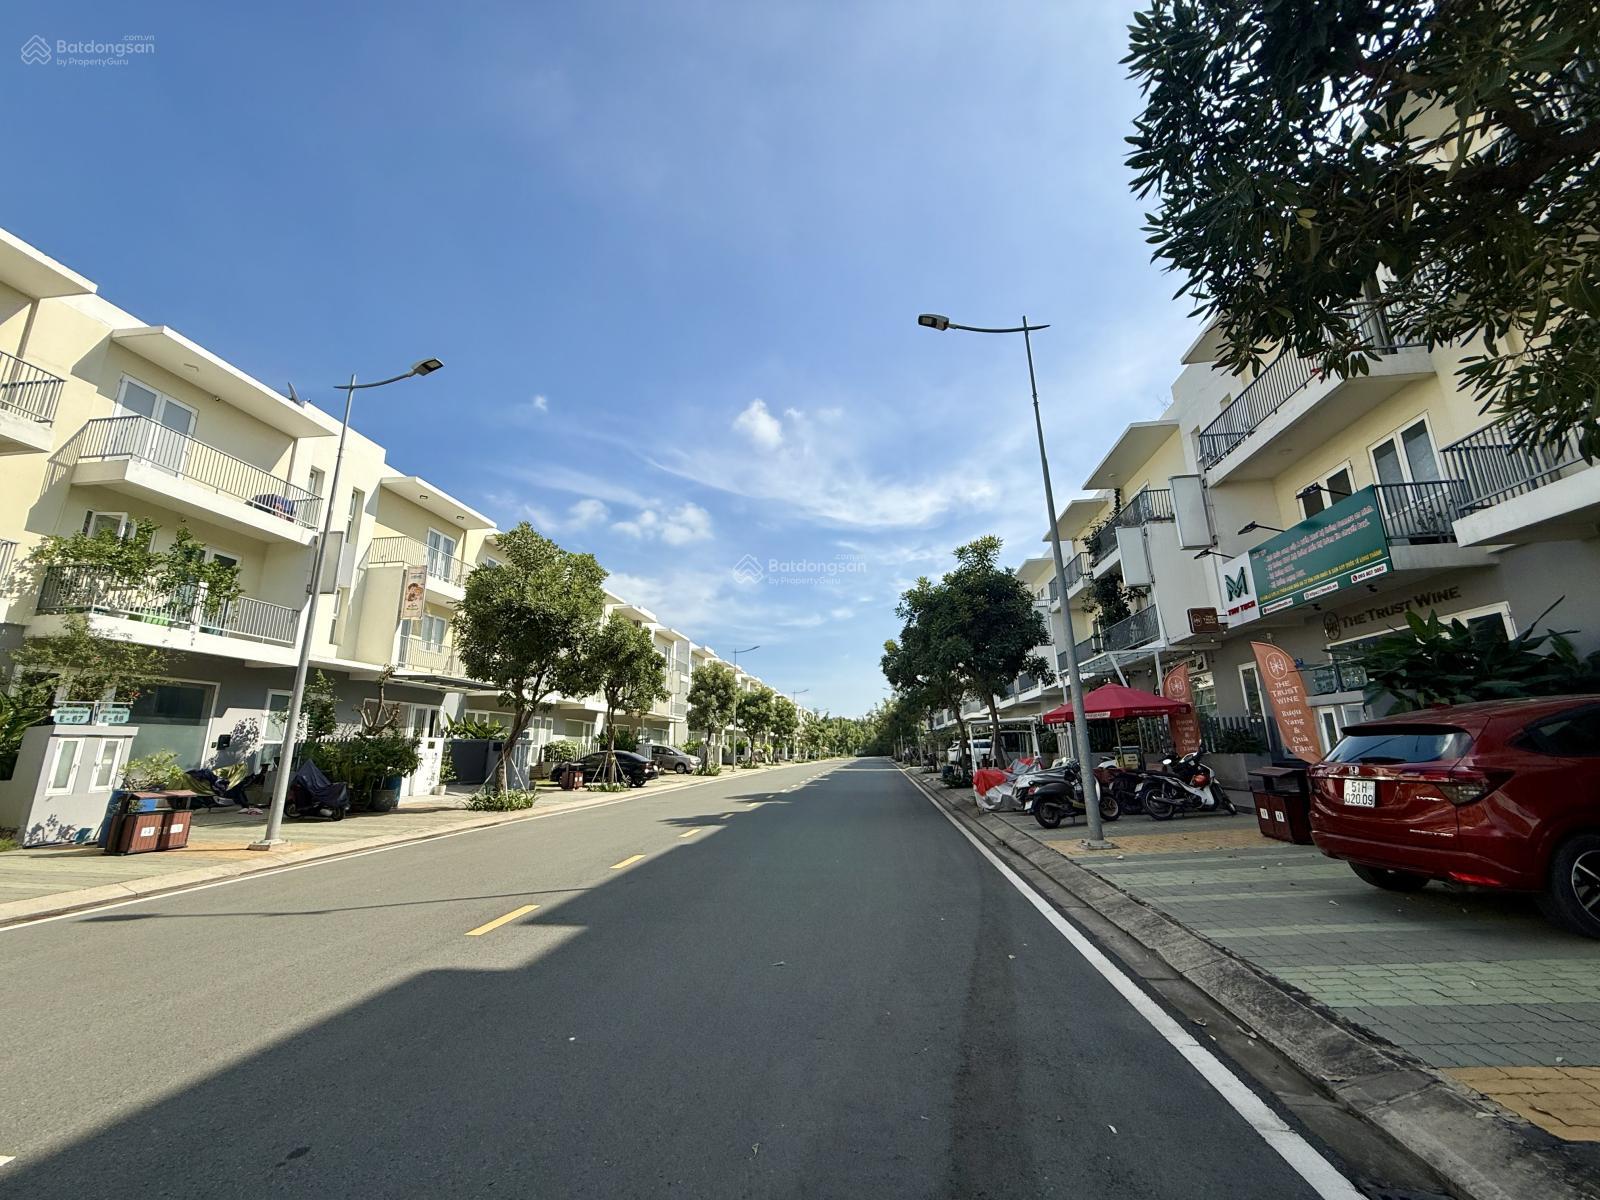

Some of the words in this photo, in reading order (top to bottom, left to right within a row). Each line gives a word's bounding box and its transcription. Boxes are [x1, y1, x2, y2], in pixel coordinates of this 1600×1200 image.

[1340, 613, 1367, 629] THE
[1366, 600, 1412, 621] TRUST
[1413, 586, 1462, 608] WINE
[1275, 680, 1292, 689] THE
[1271, 686, 1299, 698] TRUST
[1276, 696, 1300, 705] WINE
[1351, 782, 1368, 793] 51H
[1345, 793, 1374, 806] 020.09
